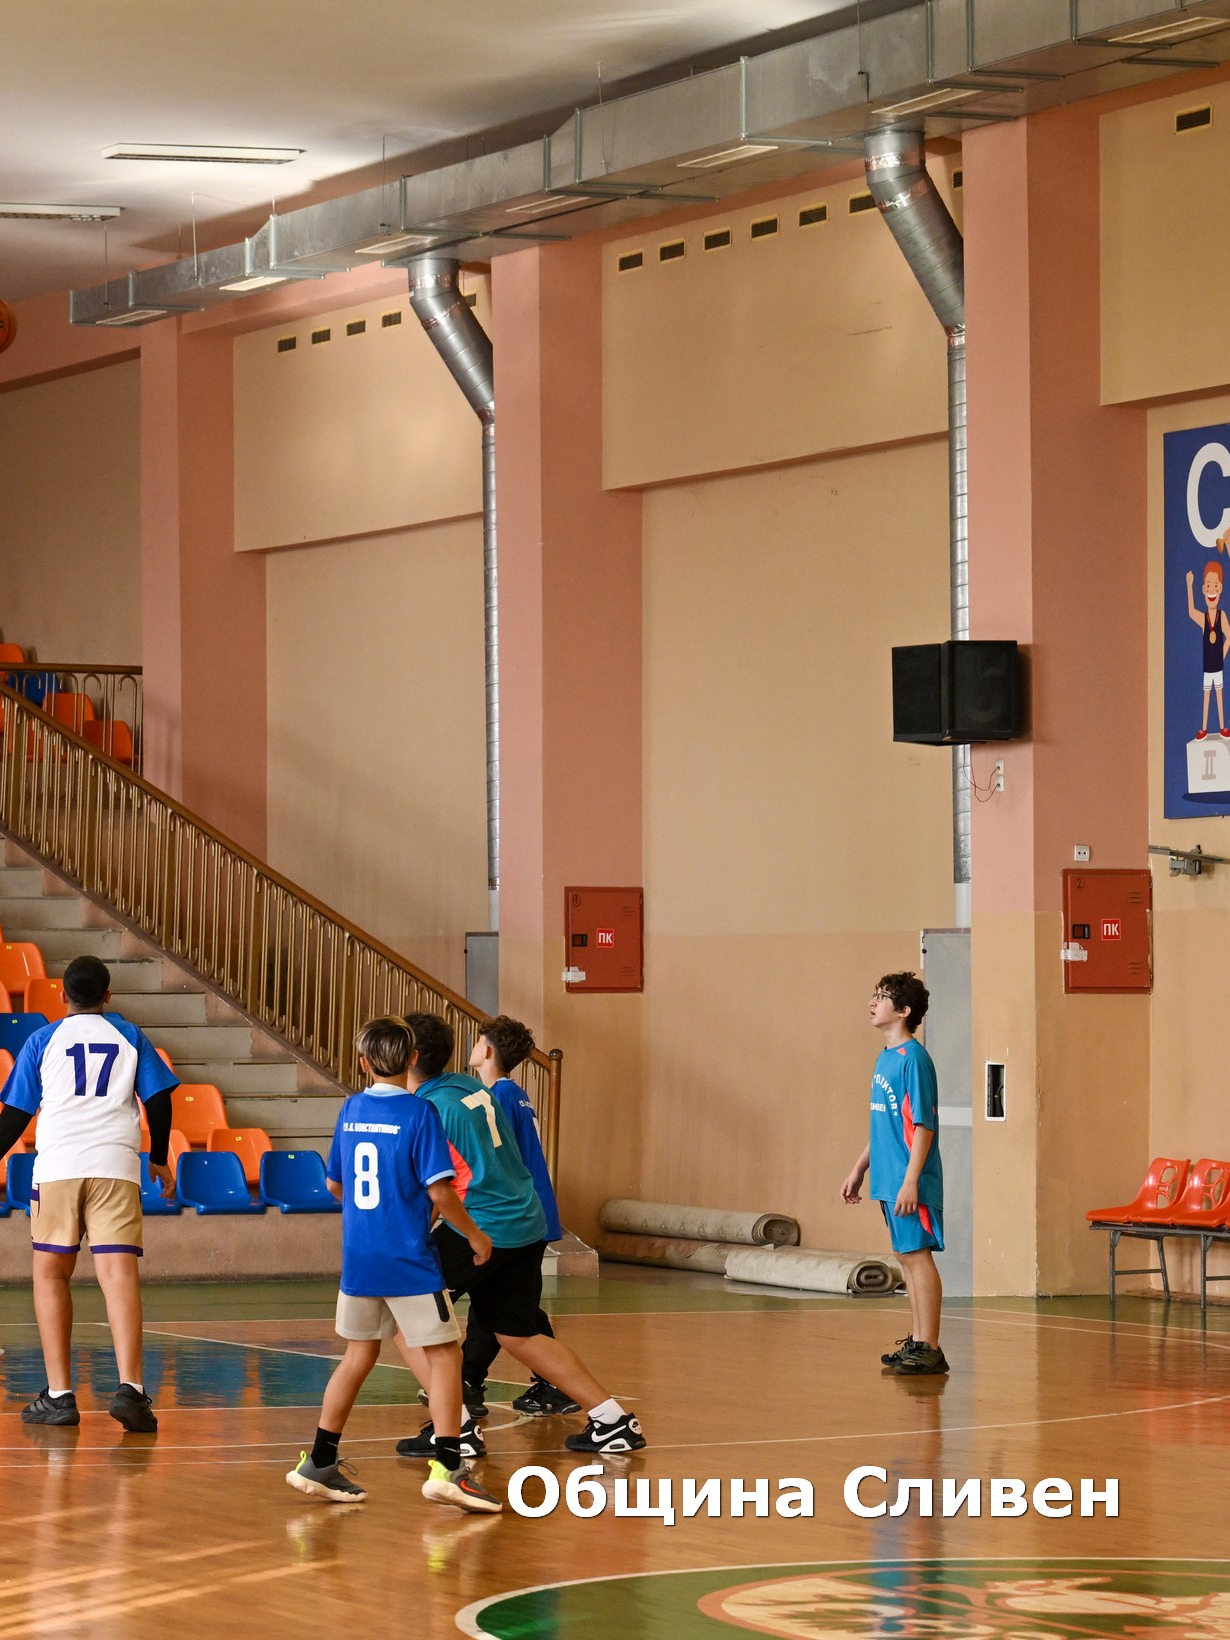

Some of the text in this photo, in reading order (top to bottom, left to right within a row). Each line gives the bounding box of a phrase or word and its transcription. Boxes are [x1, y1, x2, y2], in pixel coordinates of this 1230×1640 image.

[598, 932, 613, 944] ПК
[1103, 923, 1119, 936] ПК
[66, 1043, 119, 1097] 17
[460, 1088, 503, 1149] 7
[353, 1141, 381, 1210] 8
